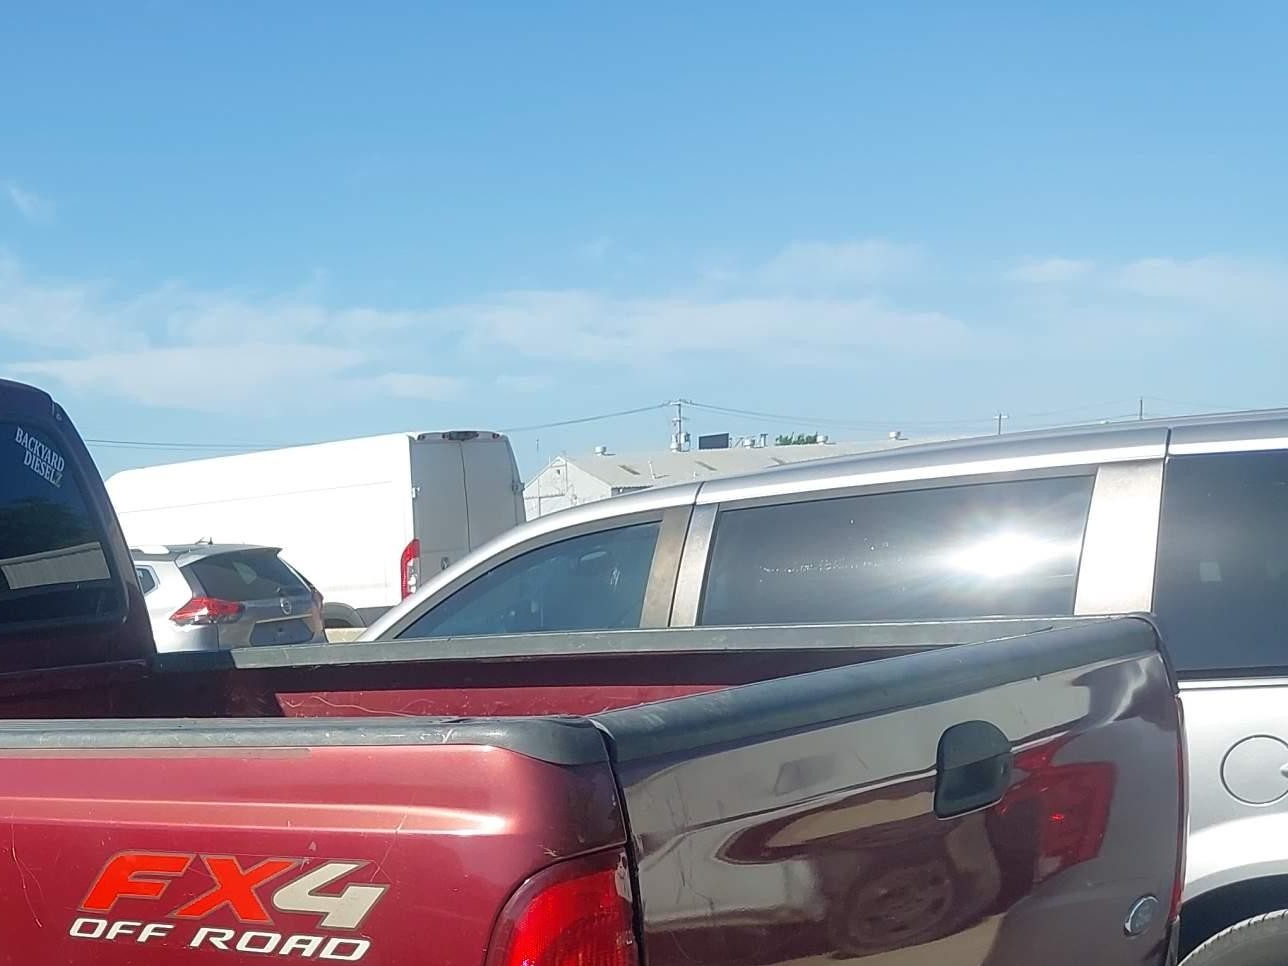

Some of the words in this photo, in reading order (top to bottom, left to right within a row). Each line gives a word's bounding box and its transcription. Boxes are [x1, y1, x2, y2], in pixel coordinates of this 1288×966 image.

[15, 426, 65, 472] BACKYARD
[23, 451, 63, 488] DIESELZ
[77, 849, 390, 930] FX4
[69, 917, 175, 943] OFF
[189, 927, 371, 961] ROAD
